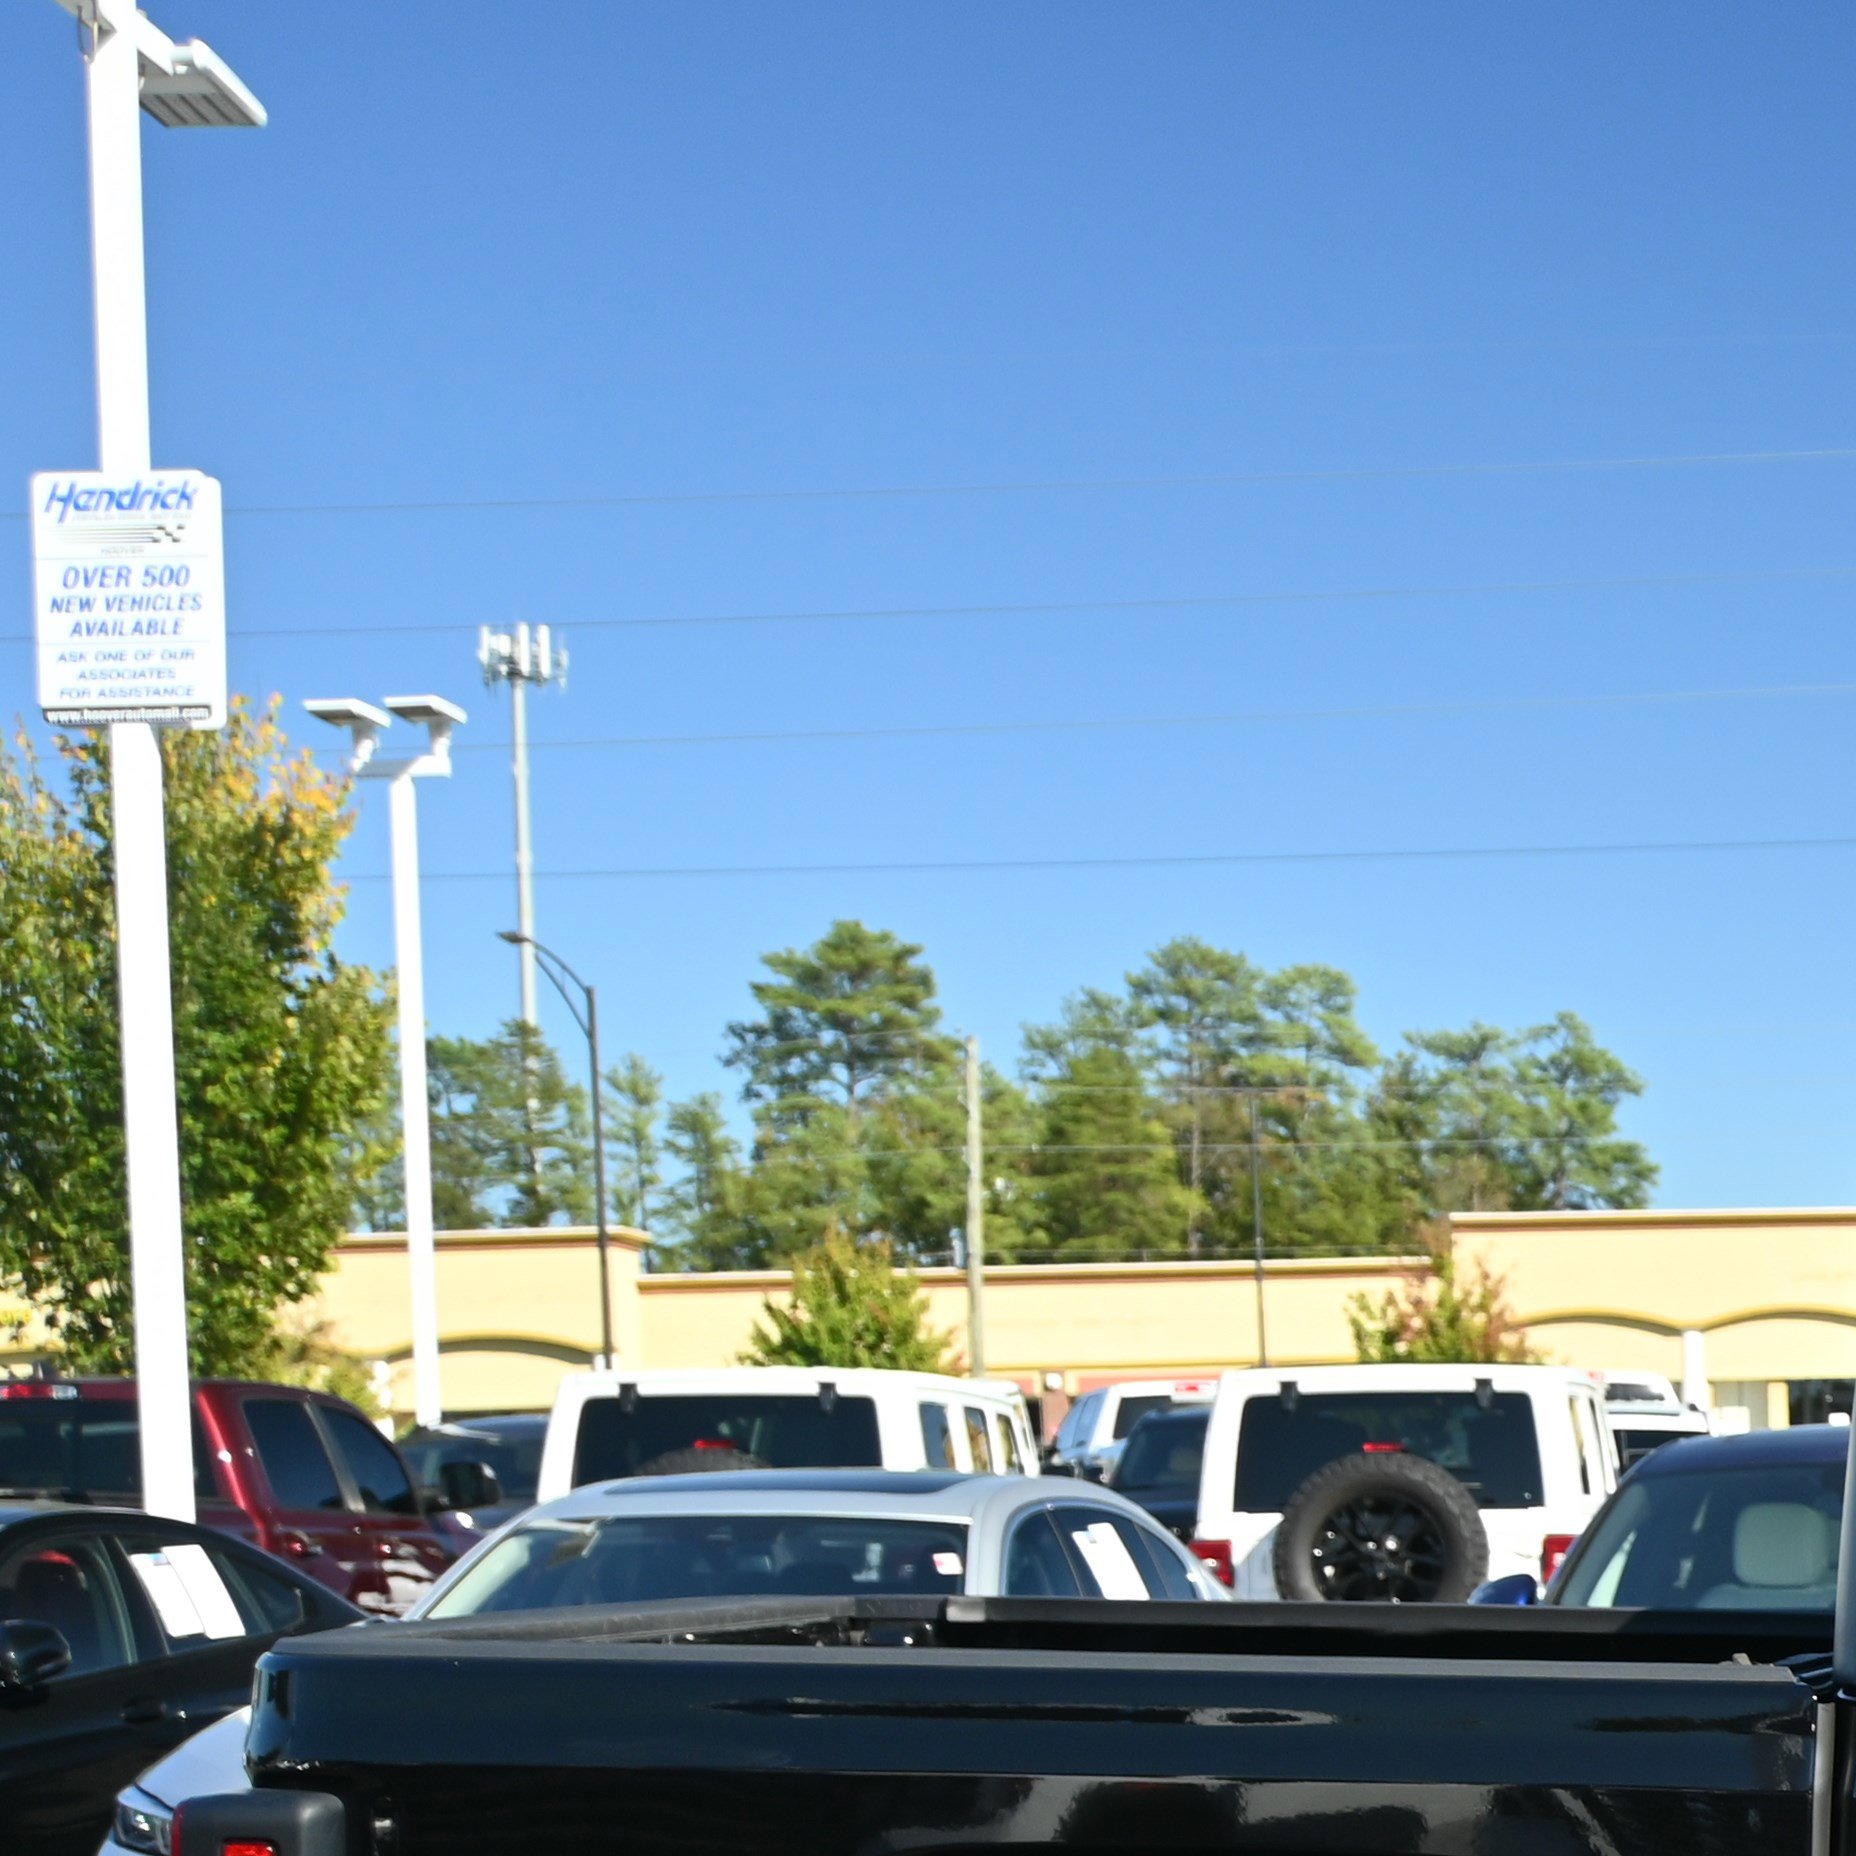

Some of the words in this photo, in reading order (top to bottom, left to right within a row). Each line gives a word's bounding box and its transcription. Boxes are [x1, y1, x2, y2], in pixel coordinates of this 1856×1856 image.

[44, 479, 198, 523] Hendrick
[62, 565, 131, 589] OVER
[142, 564, 190, 588] 500
[50, 596, 96, 613] NEW
[105, 593, 202, 612] VEHICLES
[70, 617, 184, 637] AVAILABLE
[57, 650, 87, 662] ASK
[94, 650, 128, 662] ONE
[134, 649, 154, 661] OF
[161, 648, 195, 661] OUR
[77, 667, 176, 680] ASSOCIATES
[59, 687, 91, 699] FOR
[98, 685, 195, 698] ASSISTANCE
